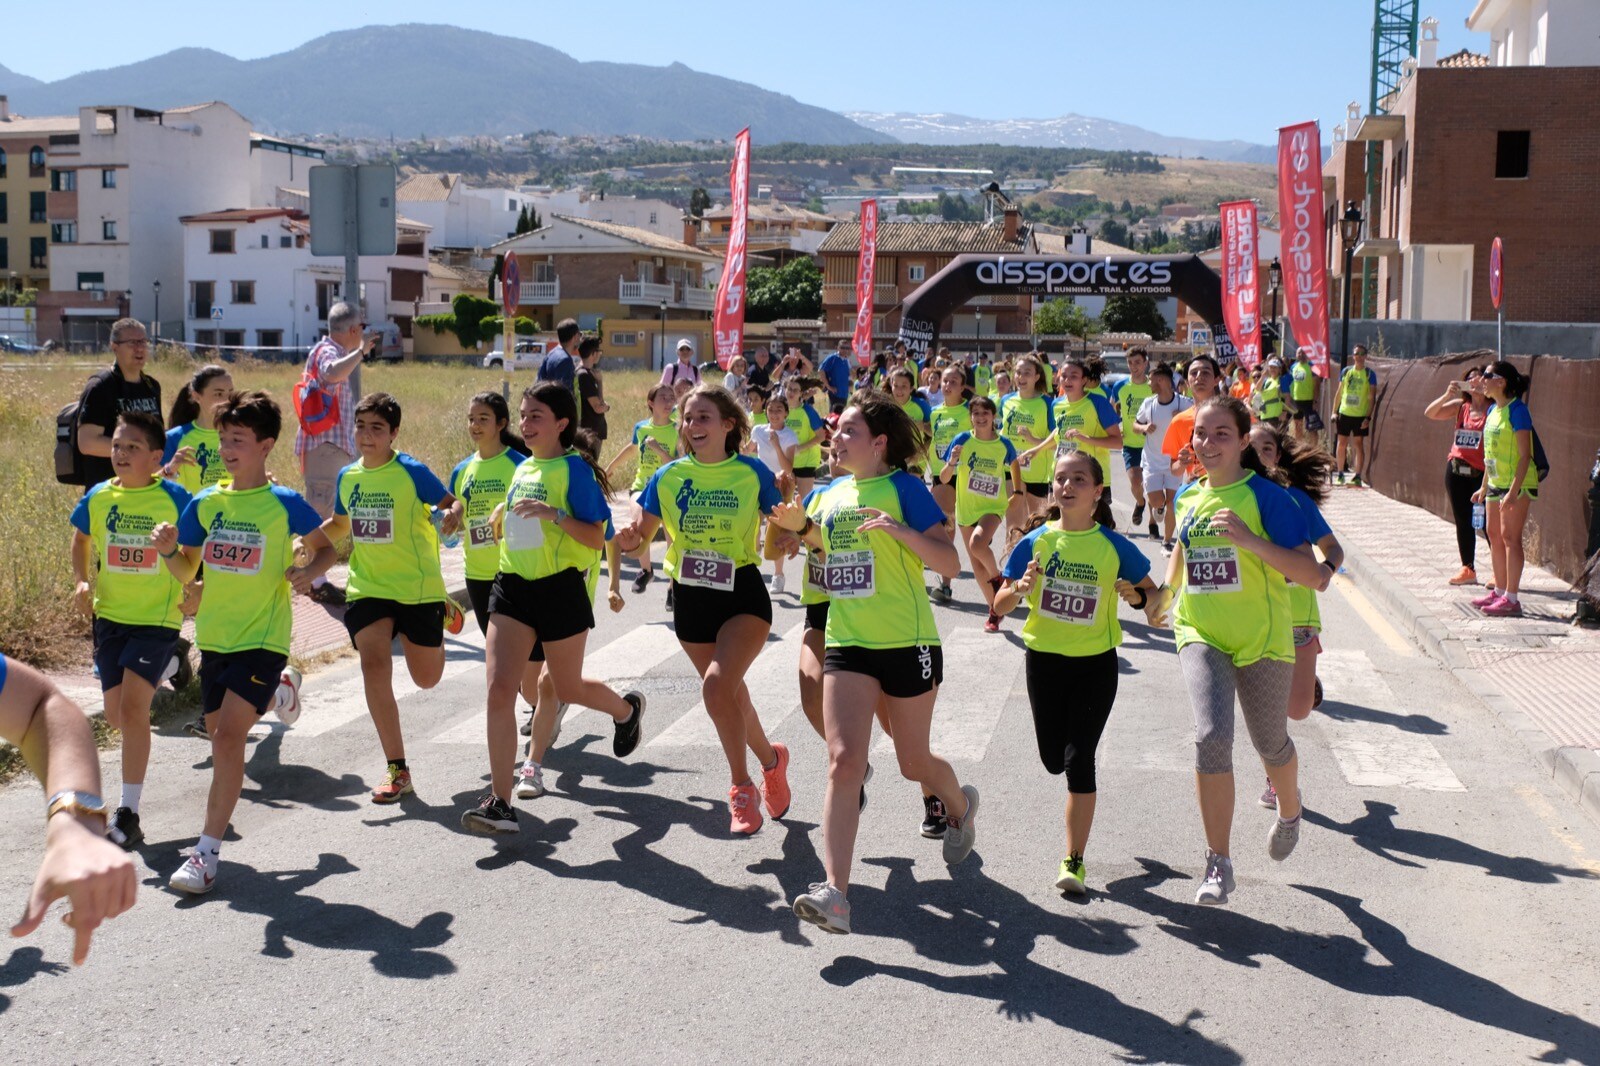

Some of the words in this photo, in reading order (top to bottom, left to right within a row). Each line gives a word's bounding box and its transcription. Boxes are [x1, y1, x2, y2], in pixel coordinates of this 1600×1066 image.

[976, 256, 1172, 293] alssport.es
[972, 480, 995, 493] 622
[709, 501, 739, 509] MUNDI
[359, 520, 378, 534] 78
[1189, 529, 1205, 537] LUX
[119, 548, 144, 563] 96
[212, 544, 252, 563] 547
[693, 560, 718, 578] 32
[831, 566, 865, 586] 256
[1073, 573, 1098, 581] MUNDI
[1192, 562, 1228, 580] 434
[1050, 593, 1085, 614] 210
[916, 645, 931, 680] adid
